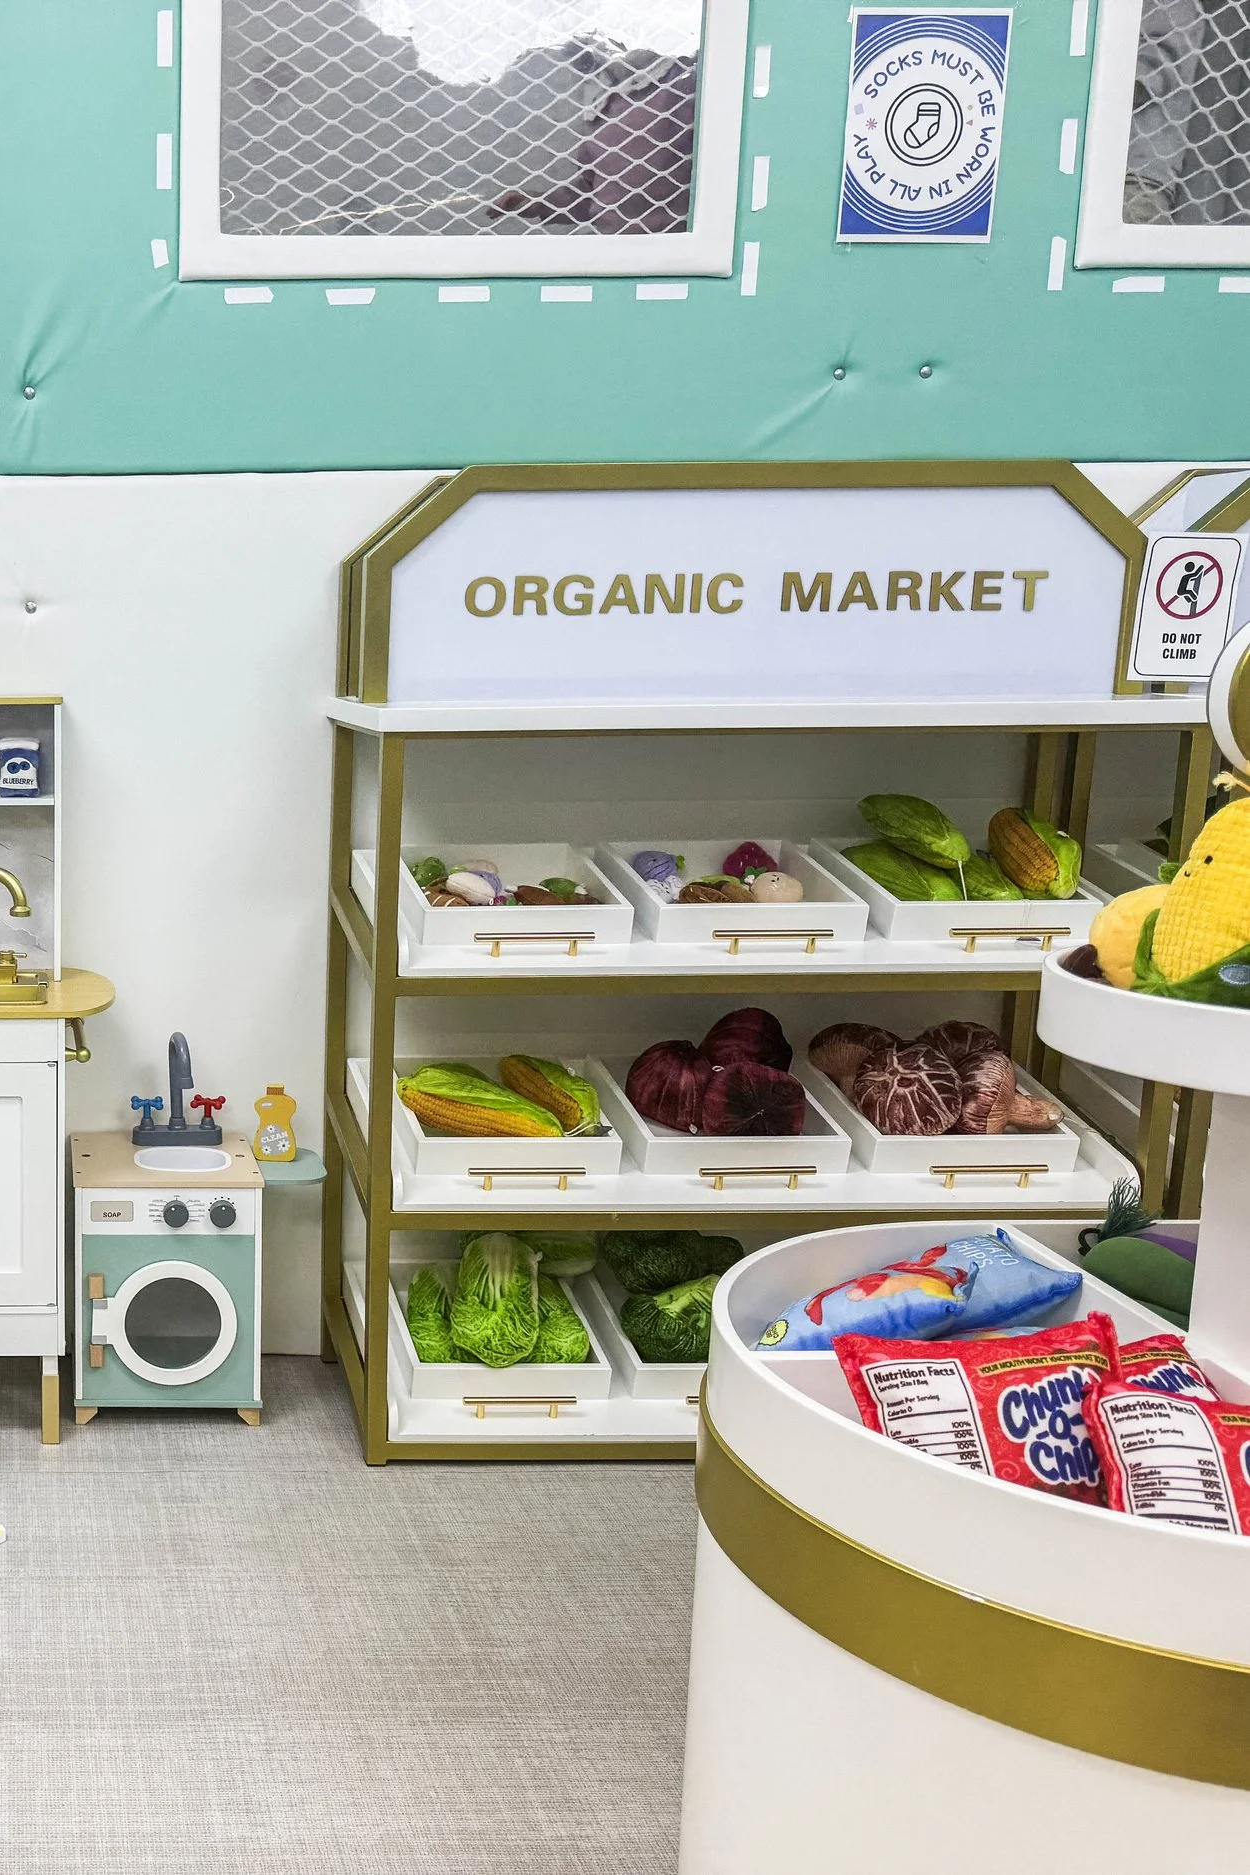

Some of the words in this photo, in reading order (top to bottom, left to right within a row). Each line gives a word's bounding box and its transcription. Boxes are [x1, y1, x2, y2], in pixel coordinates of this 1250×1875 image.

[930, 49, 985, 86] MUST
[863, 50, 924, 99] SOCKS
[977, 89, 996, 117] BE
[853, 134, 886, 185] PLAY
[956, 126, 996, 185] WORN
[889, 178, 922, 201] ALL
[929, 178, 953, 200] IN
[463, 572, 744, 618] ORGANIC
[780, 570, 1049, 612] MARKET
[1162, 632, 1177, 644] DO
[1180, 633, 1202, 645] NOT
[1162, 648, 1197, 660] CLIMB
[2, 777, 34, 785] BLUEBERRY
[261, 1131, 289, 1143] CLEAN
[102, 1211, 122, 1219] SOAP
[950, 1240, 994, 1269] CHIPS
[979, 1365, 999, 1374] YOUR
[999, 1359, 1025, 1369] MOUTH
[1025, 1356, 1049, 1365] WON'T
[873, 1368, 926, 1385] Nutrition
[927, 1366, 956, 1377] Facts
[878, 1382, 900, 1393] Serving
[900, 1379, 913, 1388] Size
[917, 1394, 940, 1403] Serving
[888, 1409, 907, 1417] Calories
[1110, 1401, 1167, 1415] Nutrition
[1167, 1402, 1196, 1416] Facts
[1113, 1413, 1139, 1423] Serving
[1140, 1411, 1153, 1419] Size
[952, 1421, 971, 1429] 100%
[954, 1431, 974, 1439] 100%
[1120, 1430, 1144, 1440] Amount
[1159, 1428, 1184, 1436] Serving
[957, 1441, 977, 1450] 100%
[1122, 1440, 1147, 1449] Calories
[960, 1453, 979, 1461] 100%
[970, 1462, 983, 1470] 0%
[1198, 1459, 1216, 1468] 100%
[1130, 1470, 1161, 1479] Enjoyable
[1200, 1469, 1219, 1478] 100%
[1131, 1480, 1157, 1489] Vitamin
[1202, 1480, 1221, 1490] 100%
[1133, 1490, 1166, 1499] Incredible
[1204, 1492, 1224, 1501] 100%
[1135, 1502, 1155, 1510] Edible
[1214, 1504, 1227, 1512] 0%
